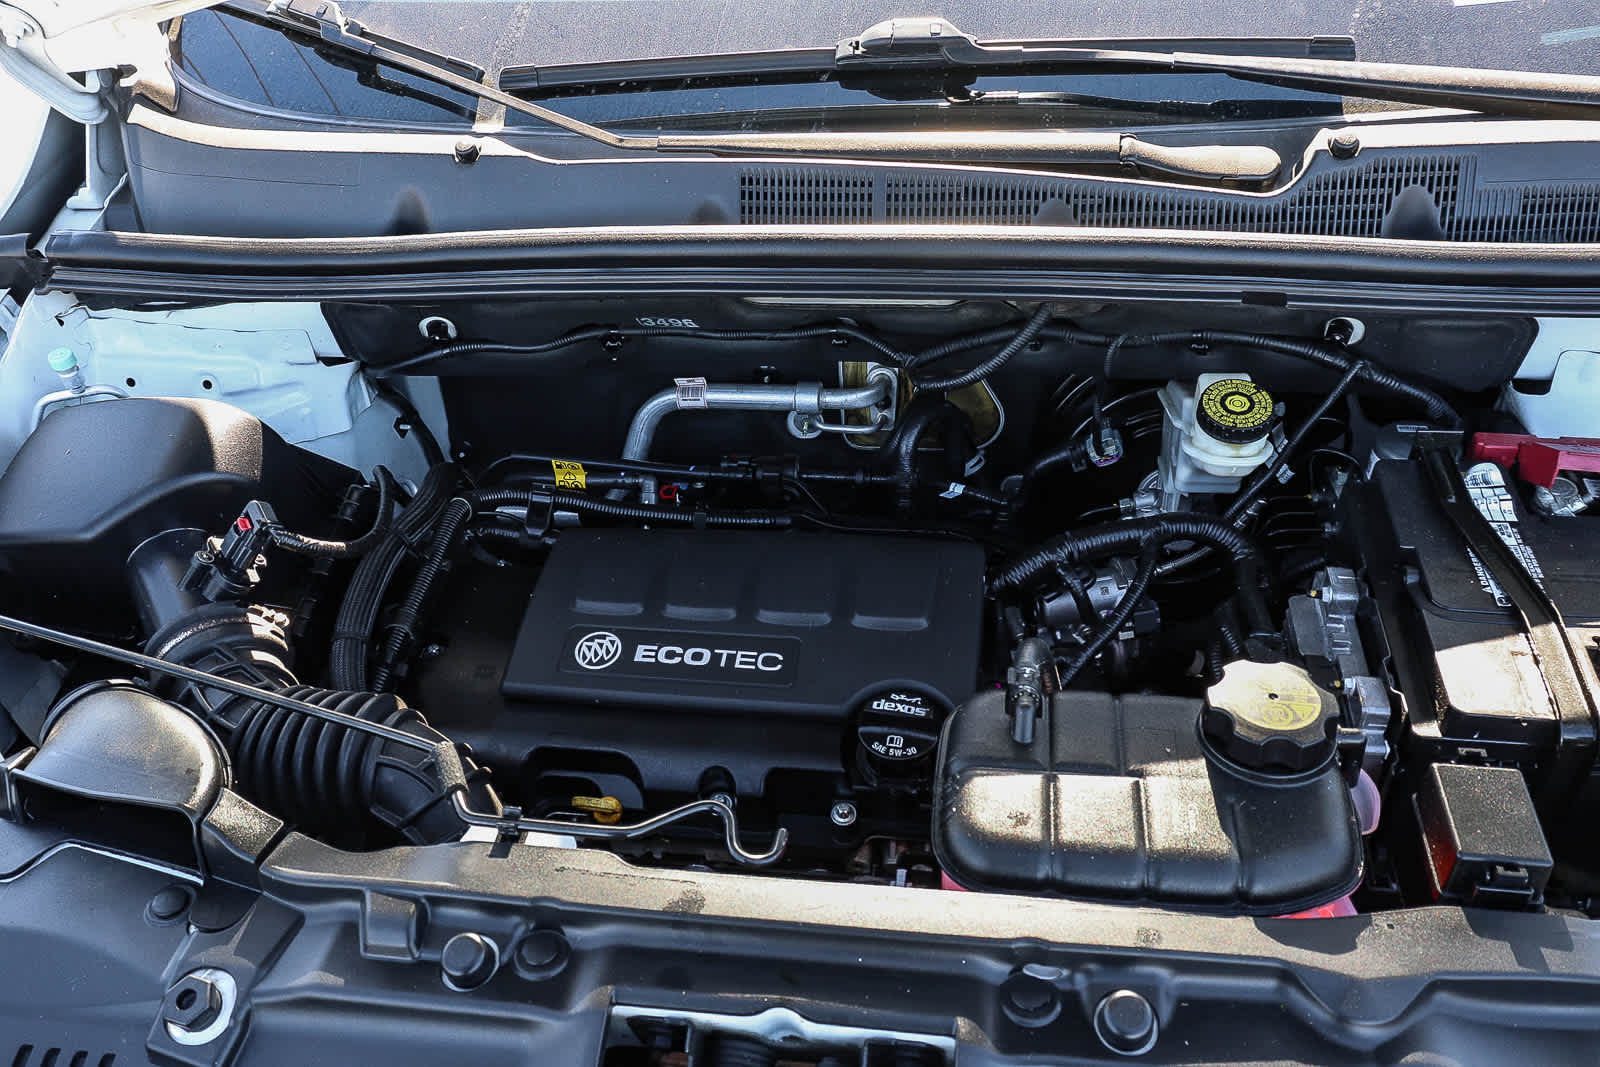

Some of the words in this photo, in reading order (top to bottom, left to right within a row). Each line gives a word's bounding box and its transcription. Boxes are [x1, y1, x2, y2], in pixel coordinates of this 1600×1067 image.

[633, 644, 784, 672] ECOTEC
[872, 698, 929, 716] dexos
[871, 741, 888, 754] SAE
[888, 746, 918, 757] 5W-30
